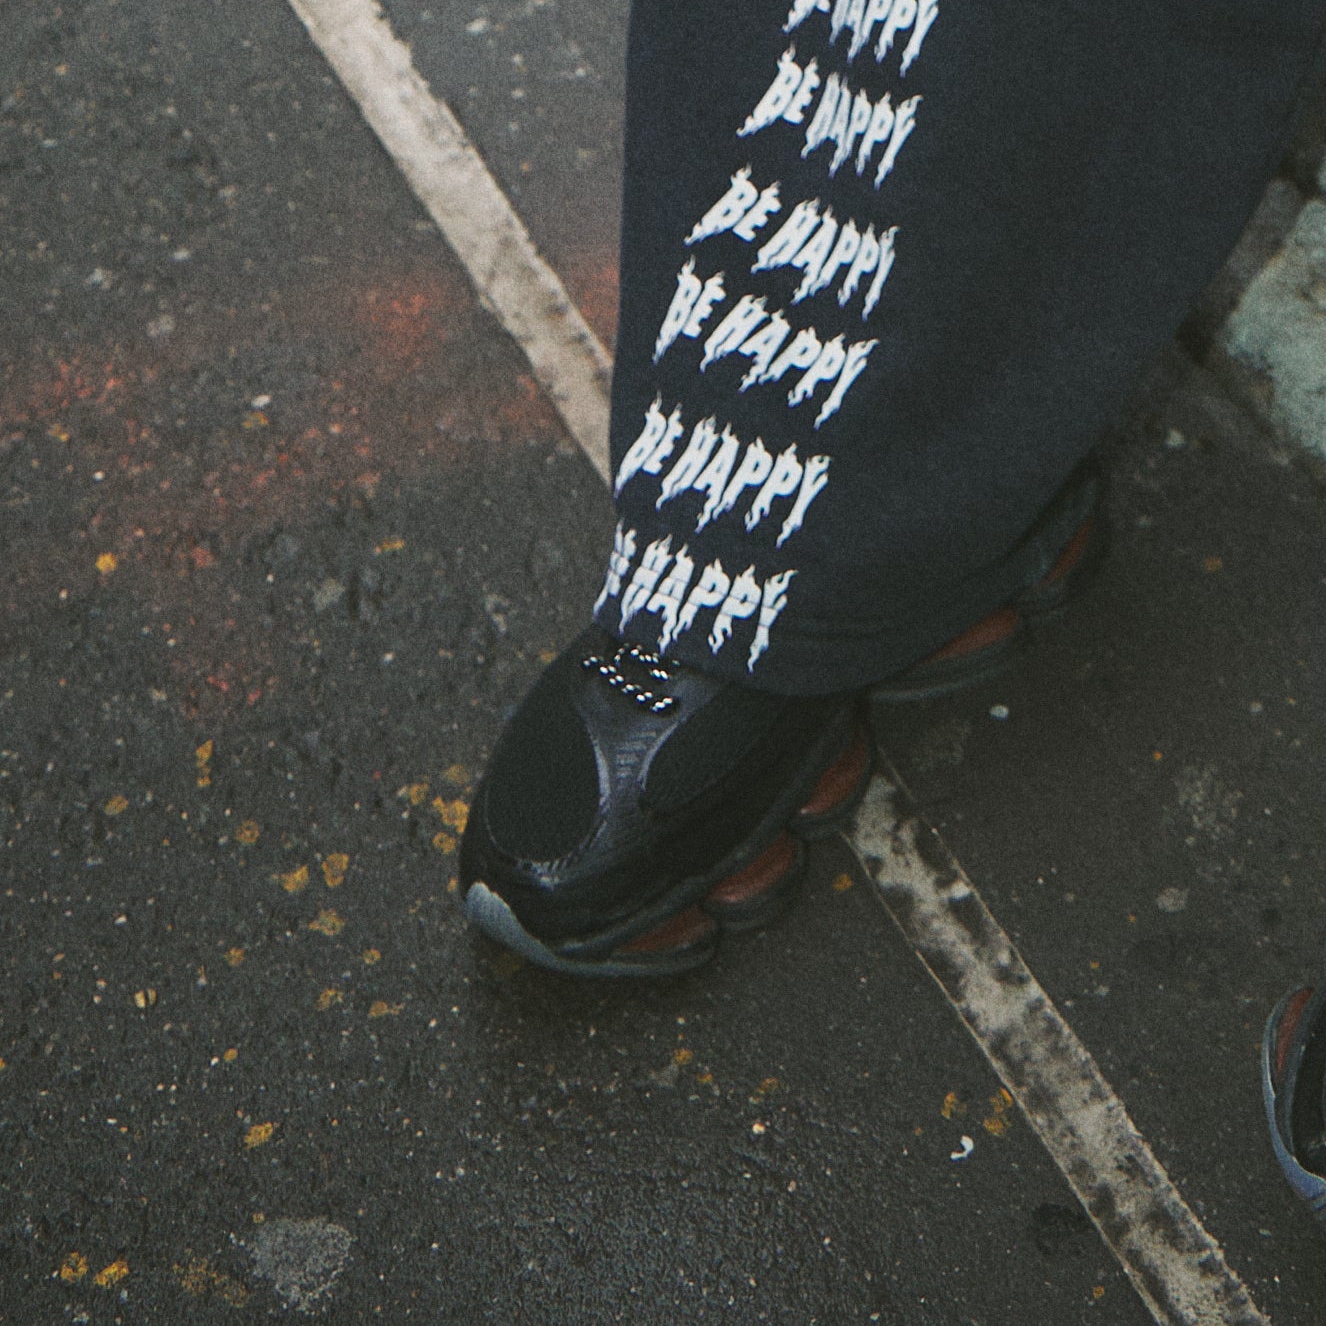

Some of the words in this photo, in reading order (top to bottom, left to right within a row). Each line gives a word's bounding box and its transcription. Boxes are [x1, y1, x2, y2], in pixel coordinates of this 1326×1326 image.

[735, 41, 821, 137] BE
[800, 71, 924, 191] HAPPY
[683, 163, 782, 246] BE
[750, 195, 900, 322] HAPPY
[652, 254, 727, 366] BE
[699, 293, 880, 431] HAPPY
[613, 389, 684, 499] BE
[655, 413, 832, 549] HAPPY
[617, 533, 798, 673] HAPPY
